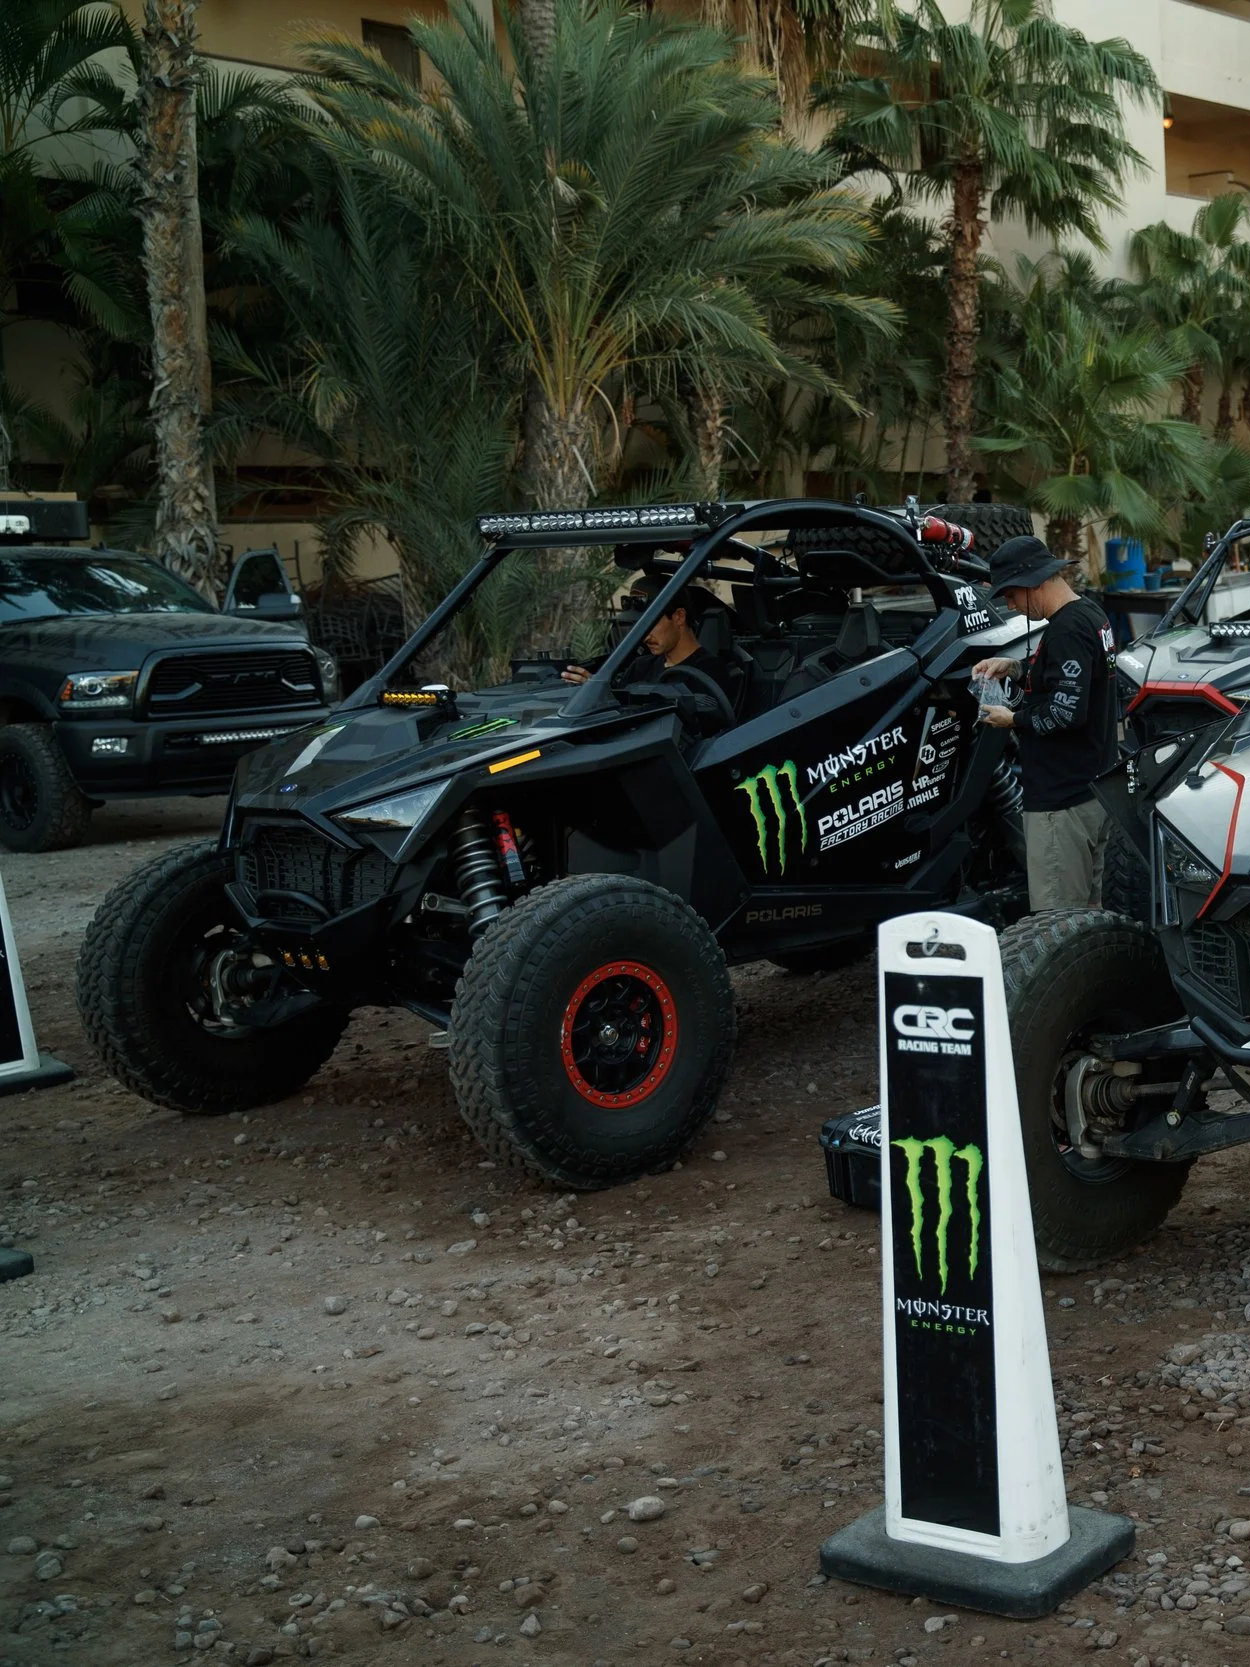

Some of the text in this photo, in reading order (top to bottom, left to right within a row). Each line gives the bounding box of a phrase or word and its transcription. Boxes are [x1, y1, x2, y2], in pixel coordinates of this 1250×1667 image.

[954, 586, 977, 607] FOX
[964, 609, 990, 629] KMC
[931, 717, 952, 732] SPICER
[806, 726, 908, 785] MONSTER
[830, 755, 896, 793] ENERGY
[818, 779, 904, 836] POLARIS
[907, 786, 940, 810] MAHLE
[820, 801, 904, 849] FACTORY RACING
[745, 903, 824, 925] POLARIS
[892, 1004, 976, 1040] CRC
[897, 1039, 972, 1056] RACING TEAM
[897, 1297, 990, 1326] MONSTER
[911, 1319, 977, 1336] ENERGY
